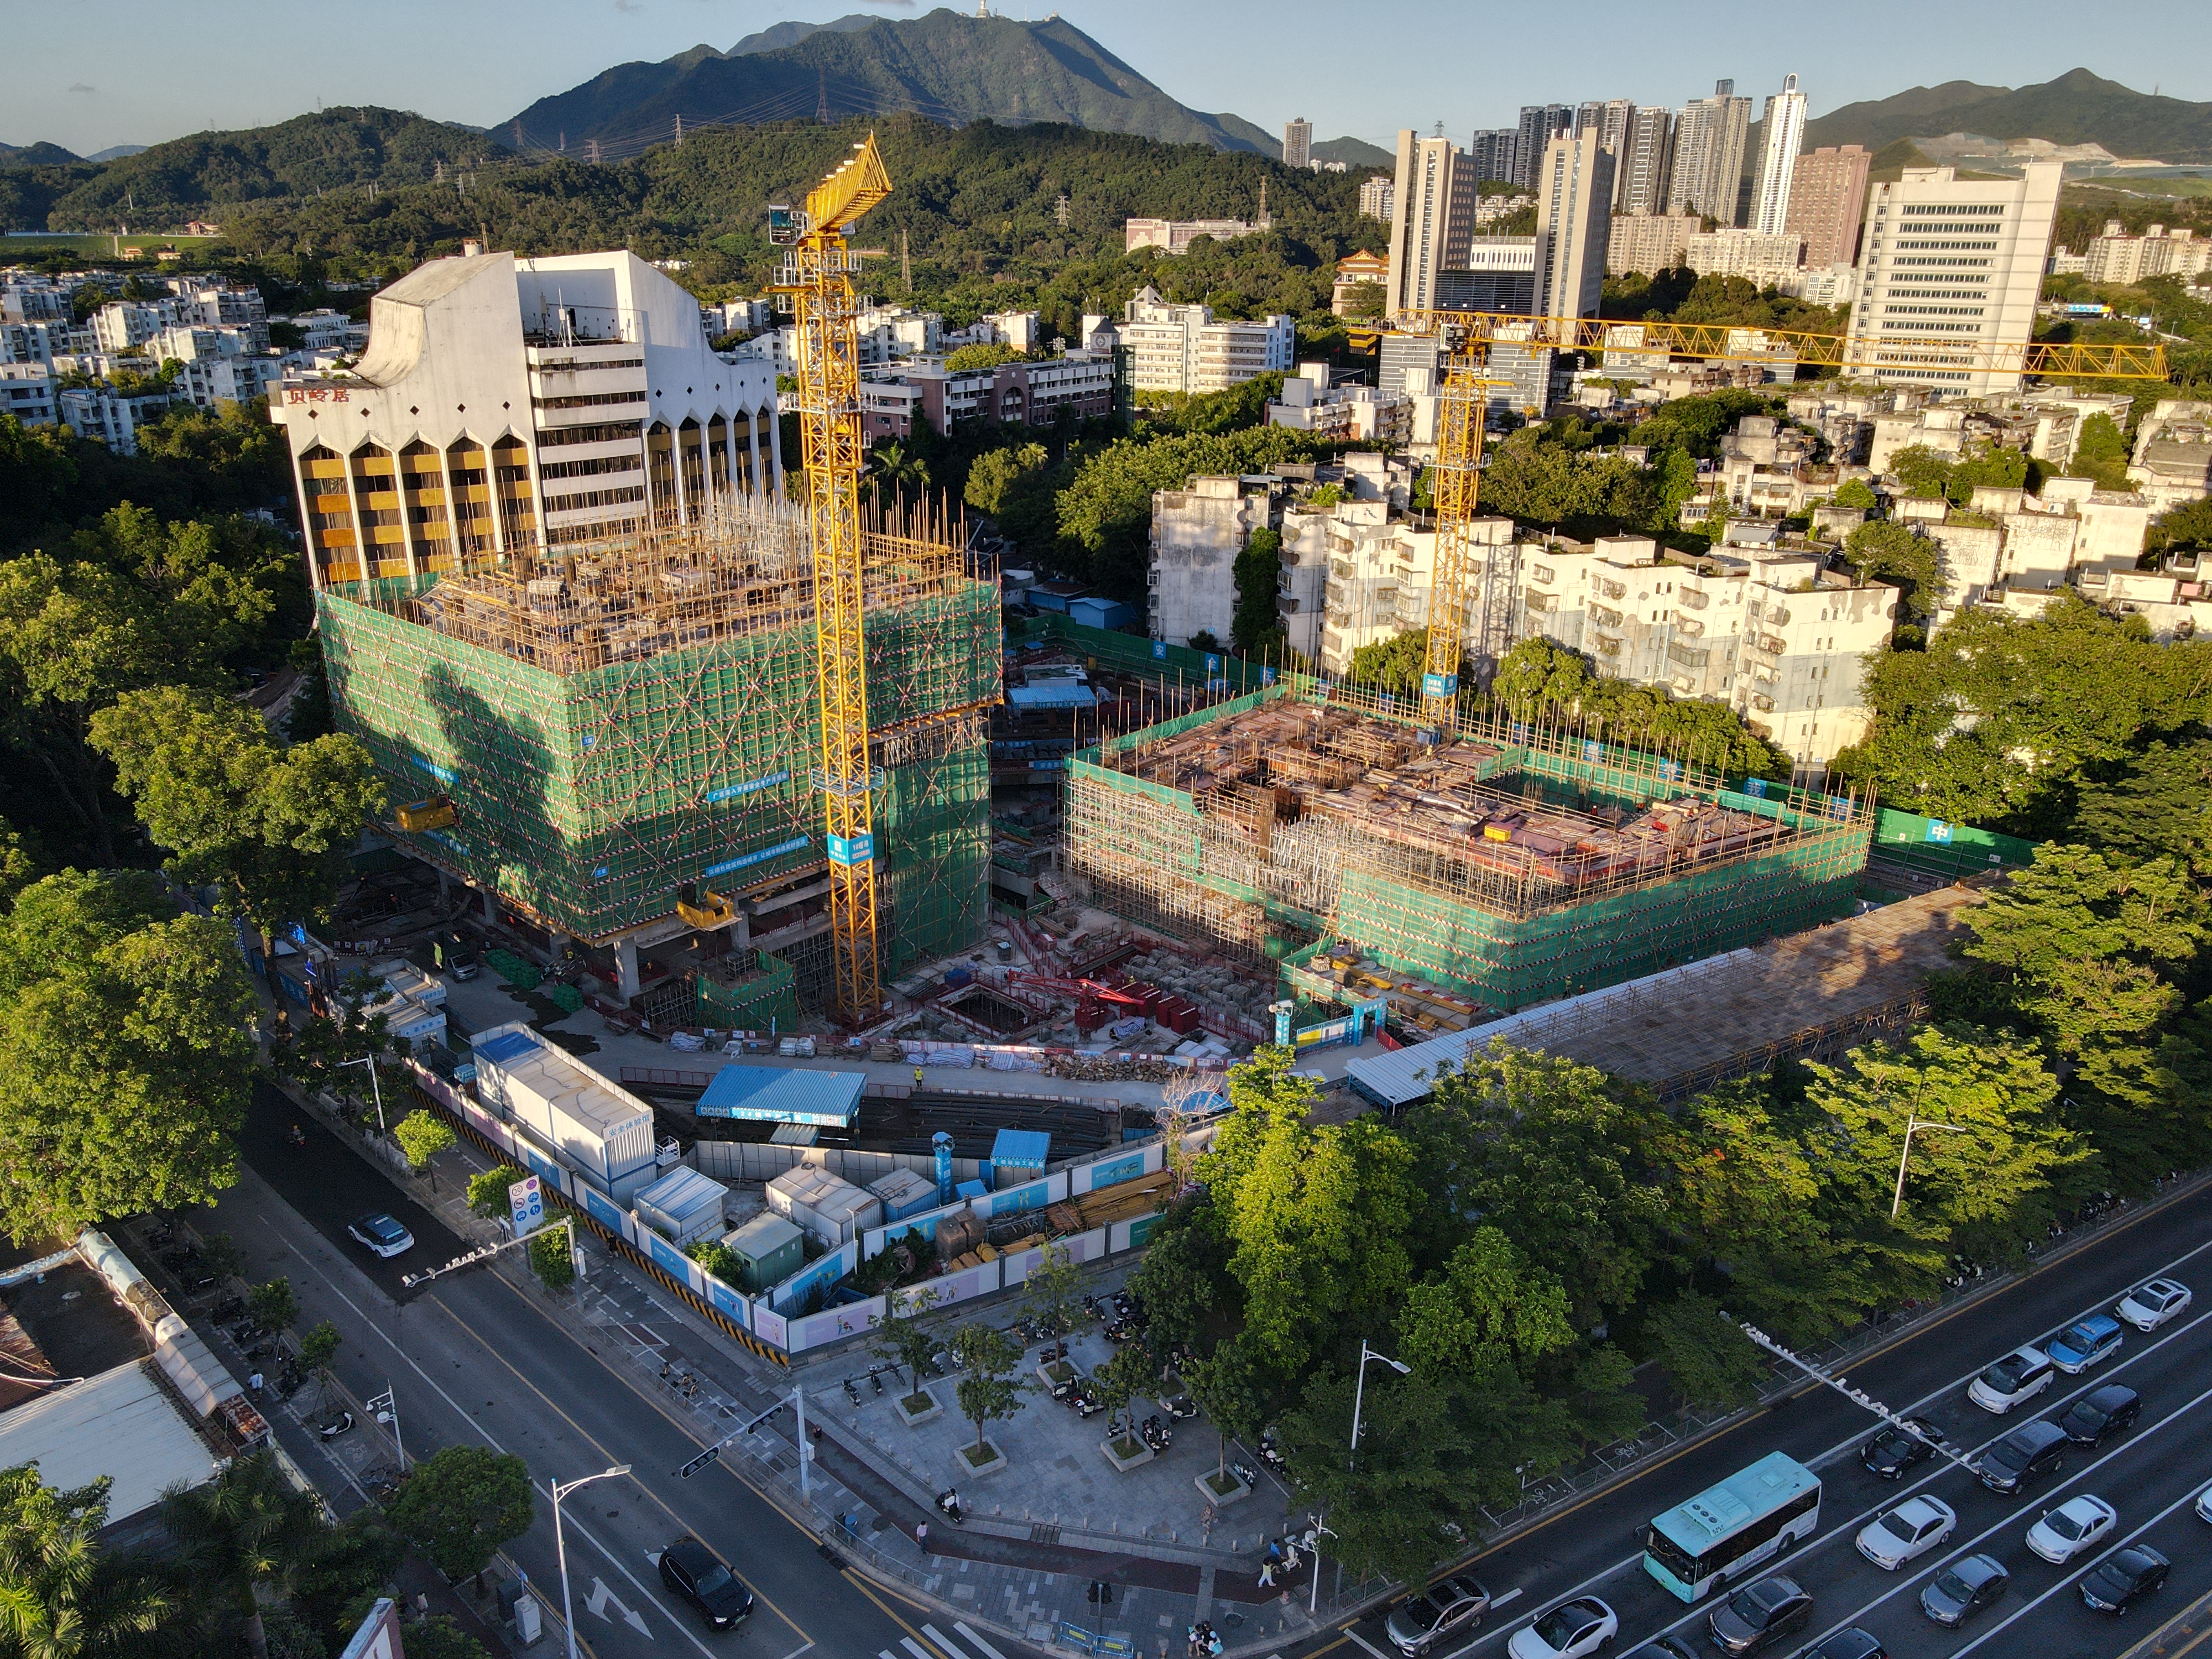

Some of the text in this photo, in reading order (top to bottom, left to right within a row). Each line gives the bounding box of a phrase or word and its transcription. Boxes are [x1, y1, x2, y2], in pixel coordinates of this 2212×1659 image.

[288, 388, 349, 404] 贝岭居
[609, 1114, 649, 1138] 安全体验馆
